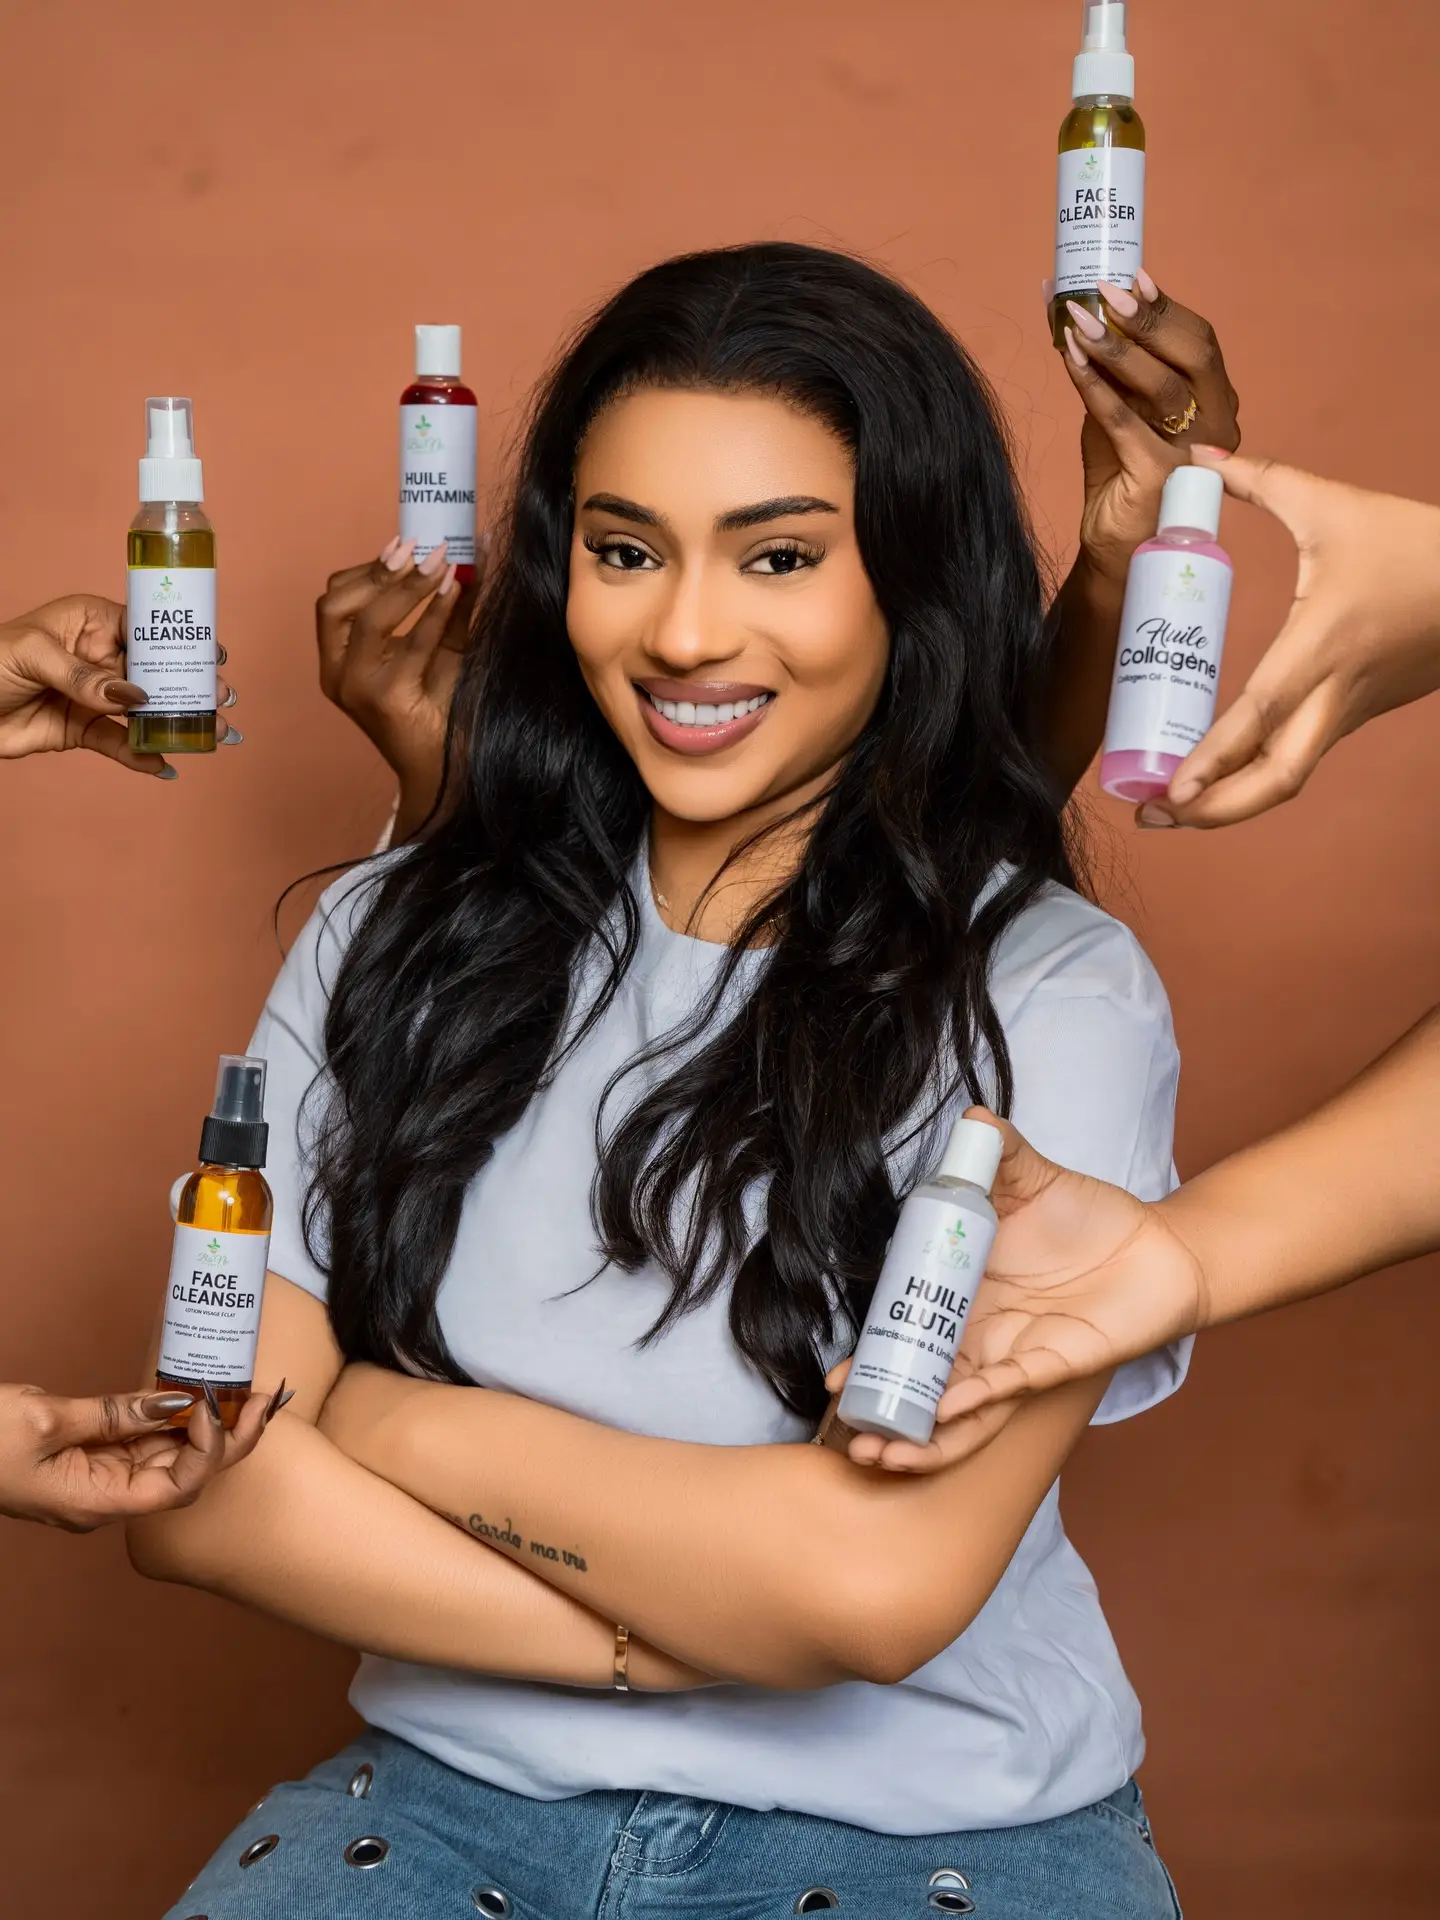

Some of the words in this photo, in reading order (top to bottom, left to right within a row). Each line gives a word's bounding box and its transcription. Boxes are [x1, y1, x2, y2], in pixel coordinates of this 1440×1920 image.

[1075, 187, 1117, 203] FACE
[1059, 204, 1135, 223] CLEANSER
[405, 472, 447, 485] HUILE
[151, 609, 194, 624] FACE
[134, 626, 212, 641] CLEANSER
[1136, 617, 1209, 649] Huile
[1120, 645, 1217, 679] Collagène
[1148, 672, 1161, 681] Oil
[192, 1270, 238, 1290] FACE
[172, 1284, 255, 1308] CLEANSER
[905, 1276, 969, 1319] HUILE
[889, 1300, 957, 1344] GLUTA
[927, 1342, 934, 1353] &
